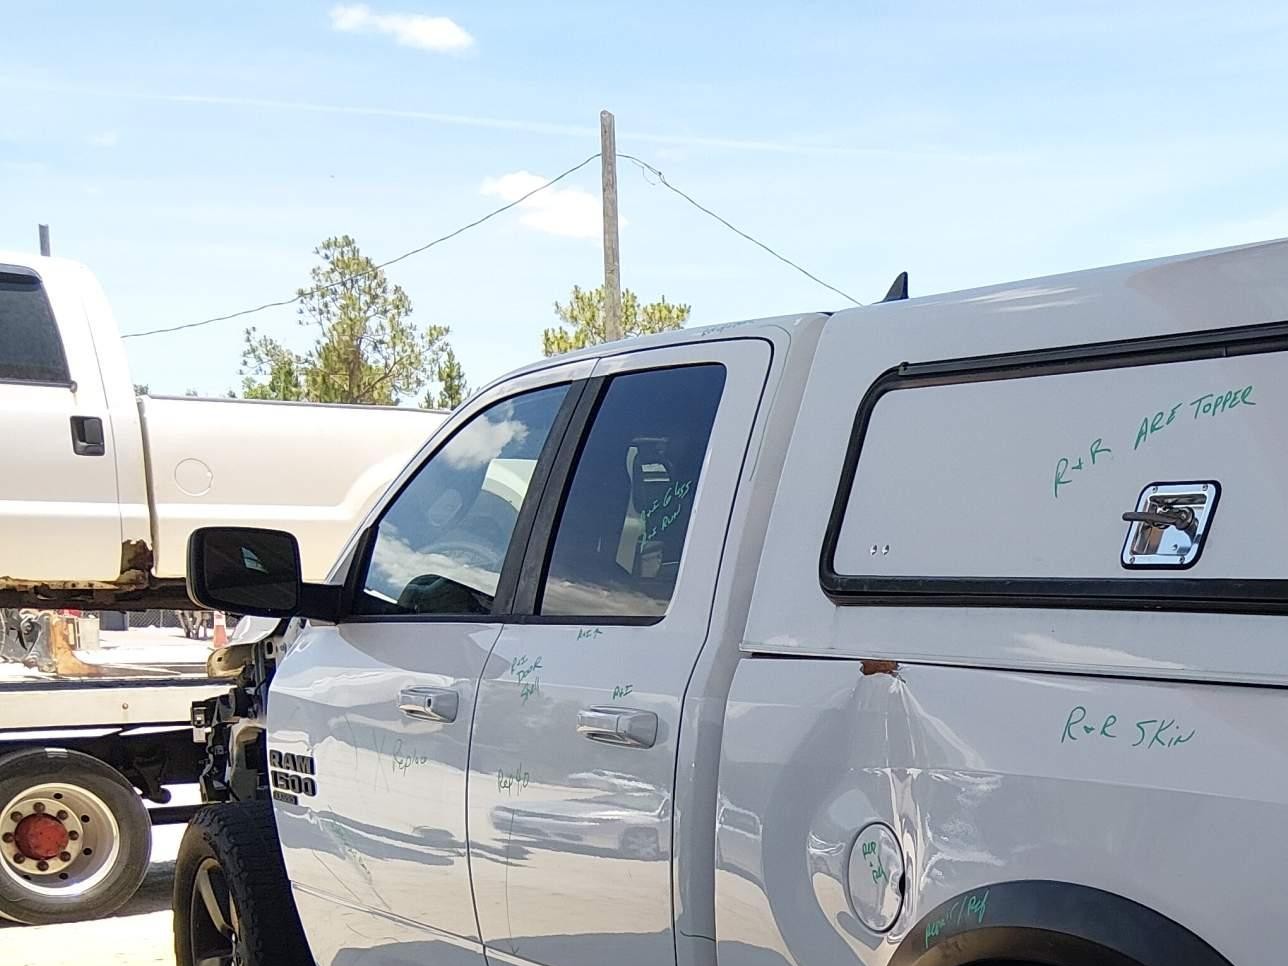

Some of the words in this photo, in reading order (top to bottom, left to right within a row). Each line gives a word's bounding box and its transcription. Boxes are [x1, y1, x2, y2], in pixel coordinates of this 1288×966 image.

[1134, 403, 1182, 450] ARE
[1189, 385, 1257, 419] TOPPER
[269, 749, 315, 776] RAM
[270, 770, 318, 797] 1500
